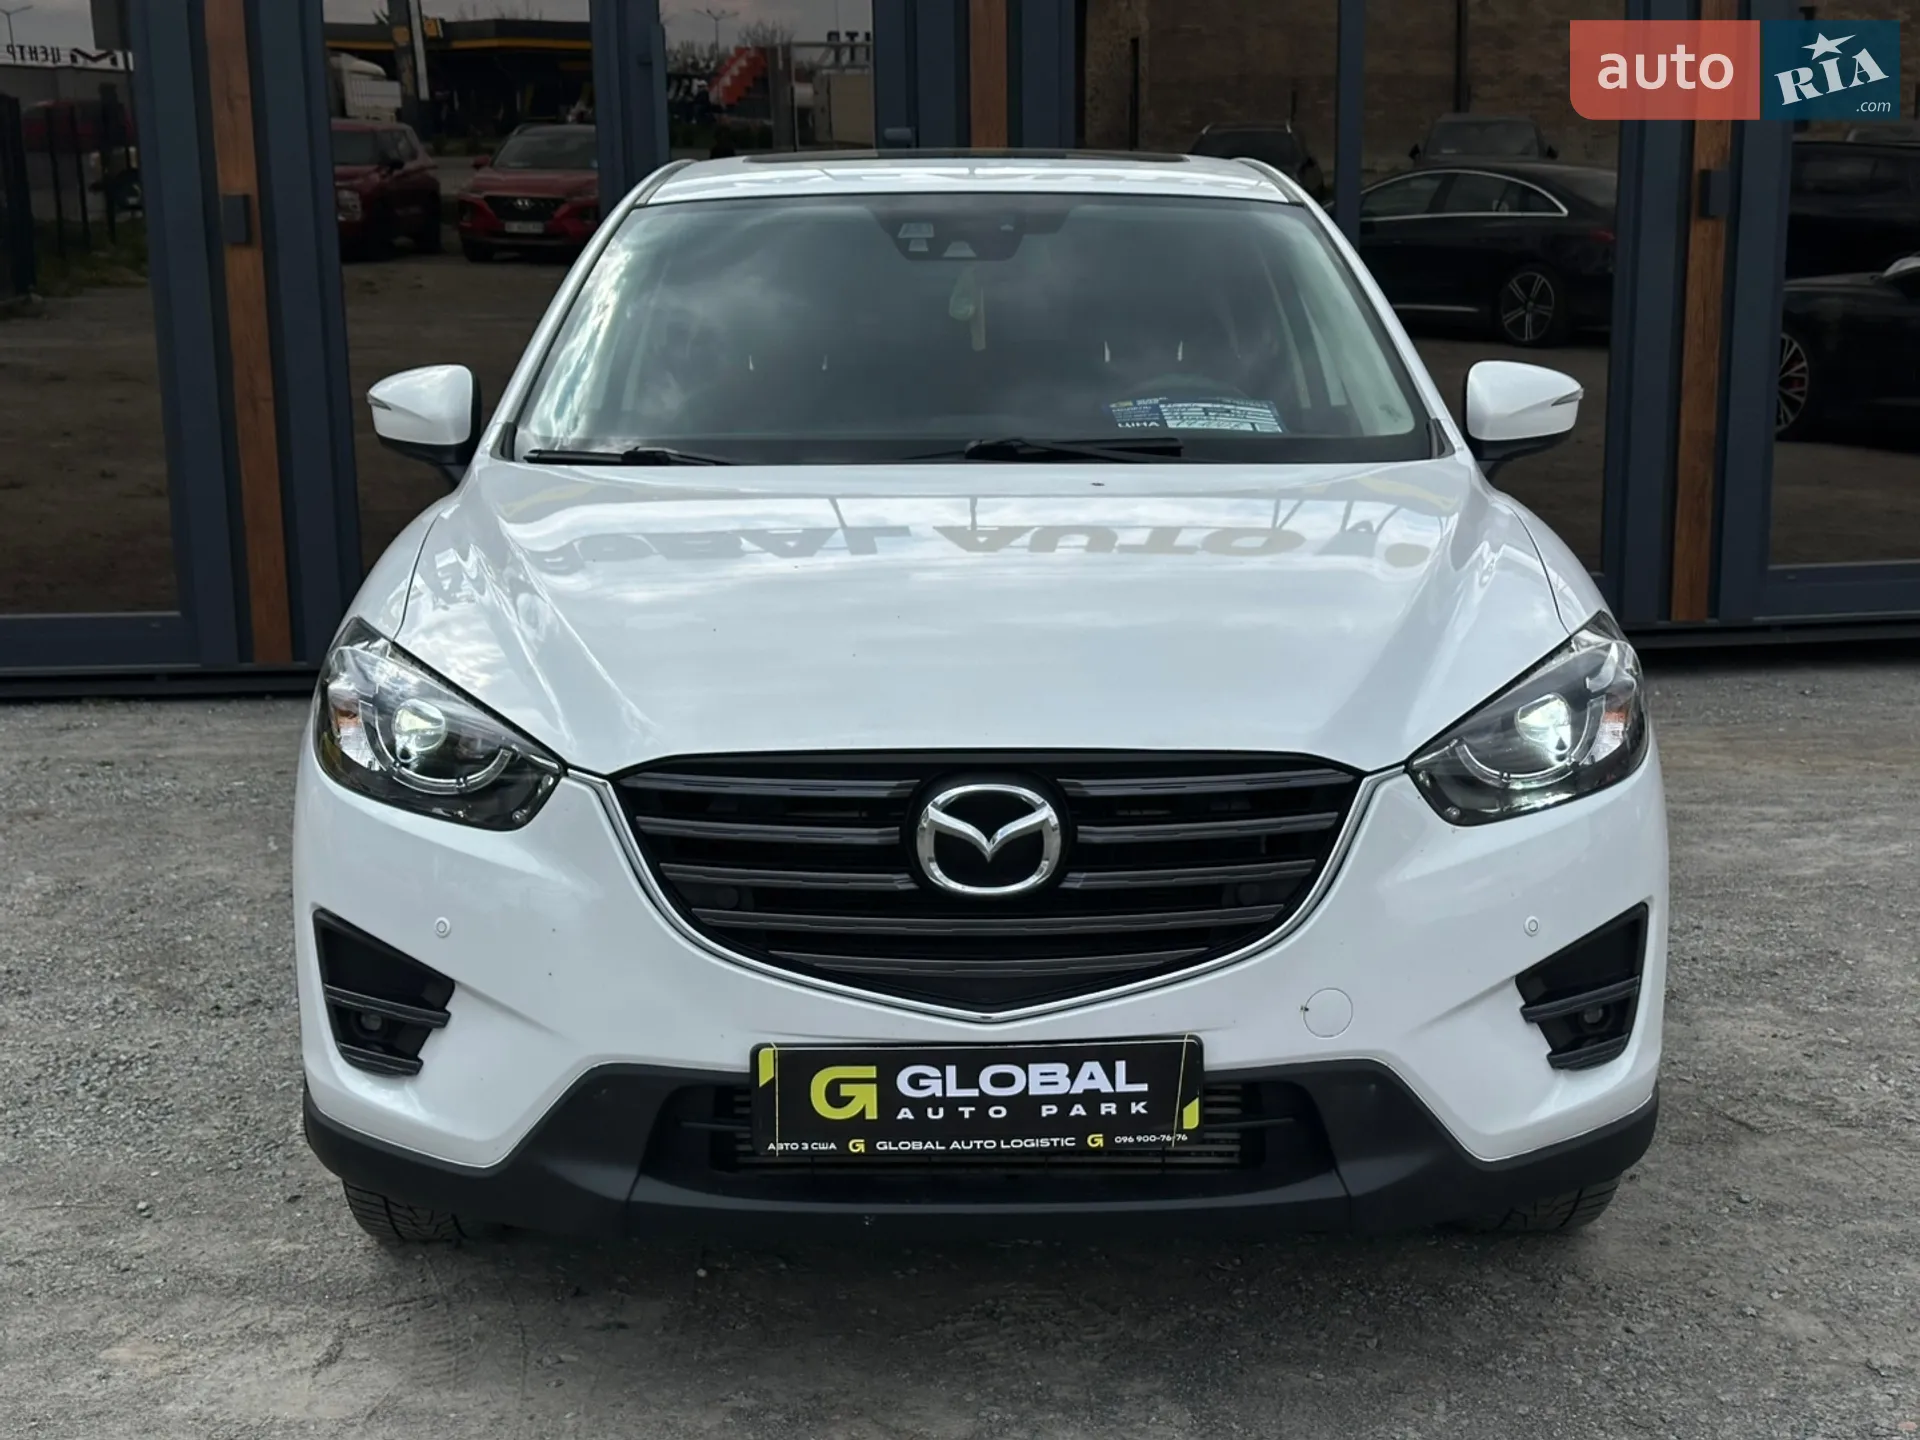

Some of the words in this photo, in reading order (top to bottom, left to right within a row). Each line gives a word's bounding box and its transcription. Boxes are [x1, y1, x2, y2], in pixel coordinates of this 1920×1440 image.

[896, 1060, 1149, 1098] GLOBAL
[897, 1105, 1008, 1120] AUTO
[1041, 1101, 1149, 1117] PARK
[767, 1142, 799, 1151] АВТО
[810, 1141, 837, 1151] США
[875, 1139, 947, 1151] GLOBAL
[949, 1138, 998, 1150] AUTO
[1000, 1136, 1076, 1149] LOGISTIC
[1114, 1136, 1134, 1144] 096
